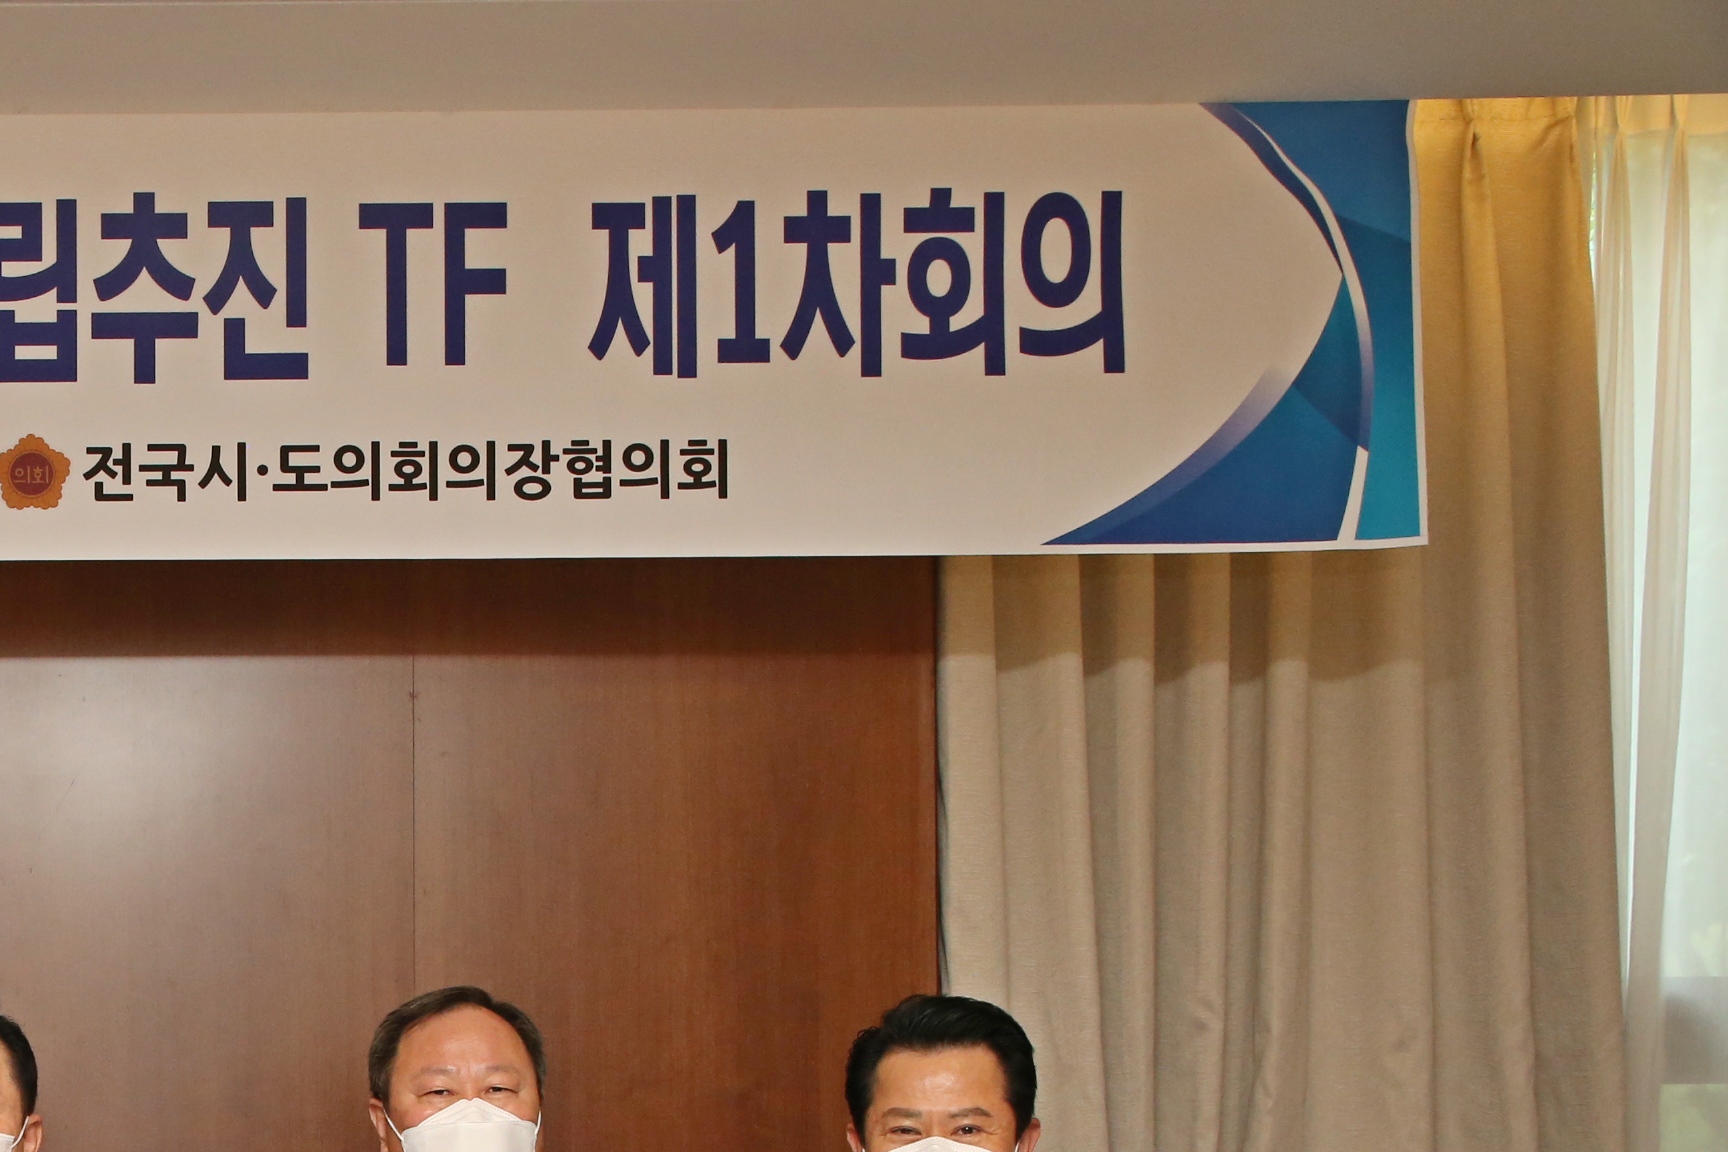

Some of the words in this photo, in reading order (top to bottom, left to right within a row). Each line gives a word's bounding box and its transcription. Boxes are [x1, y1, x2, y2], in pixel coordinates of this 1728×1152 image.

[358, 201, 508, 367] TF
[587, 187, 1126, 379] 제1차회의
[12, 464, 50, 484] 의회
[82, 438, 728, 503] 전국시·도의회의장협의회
